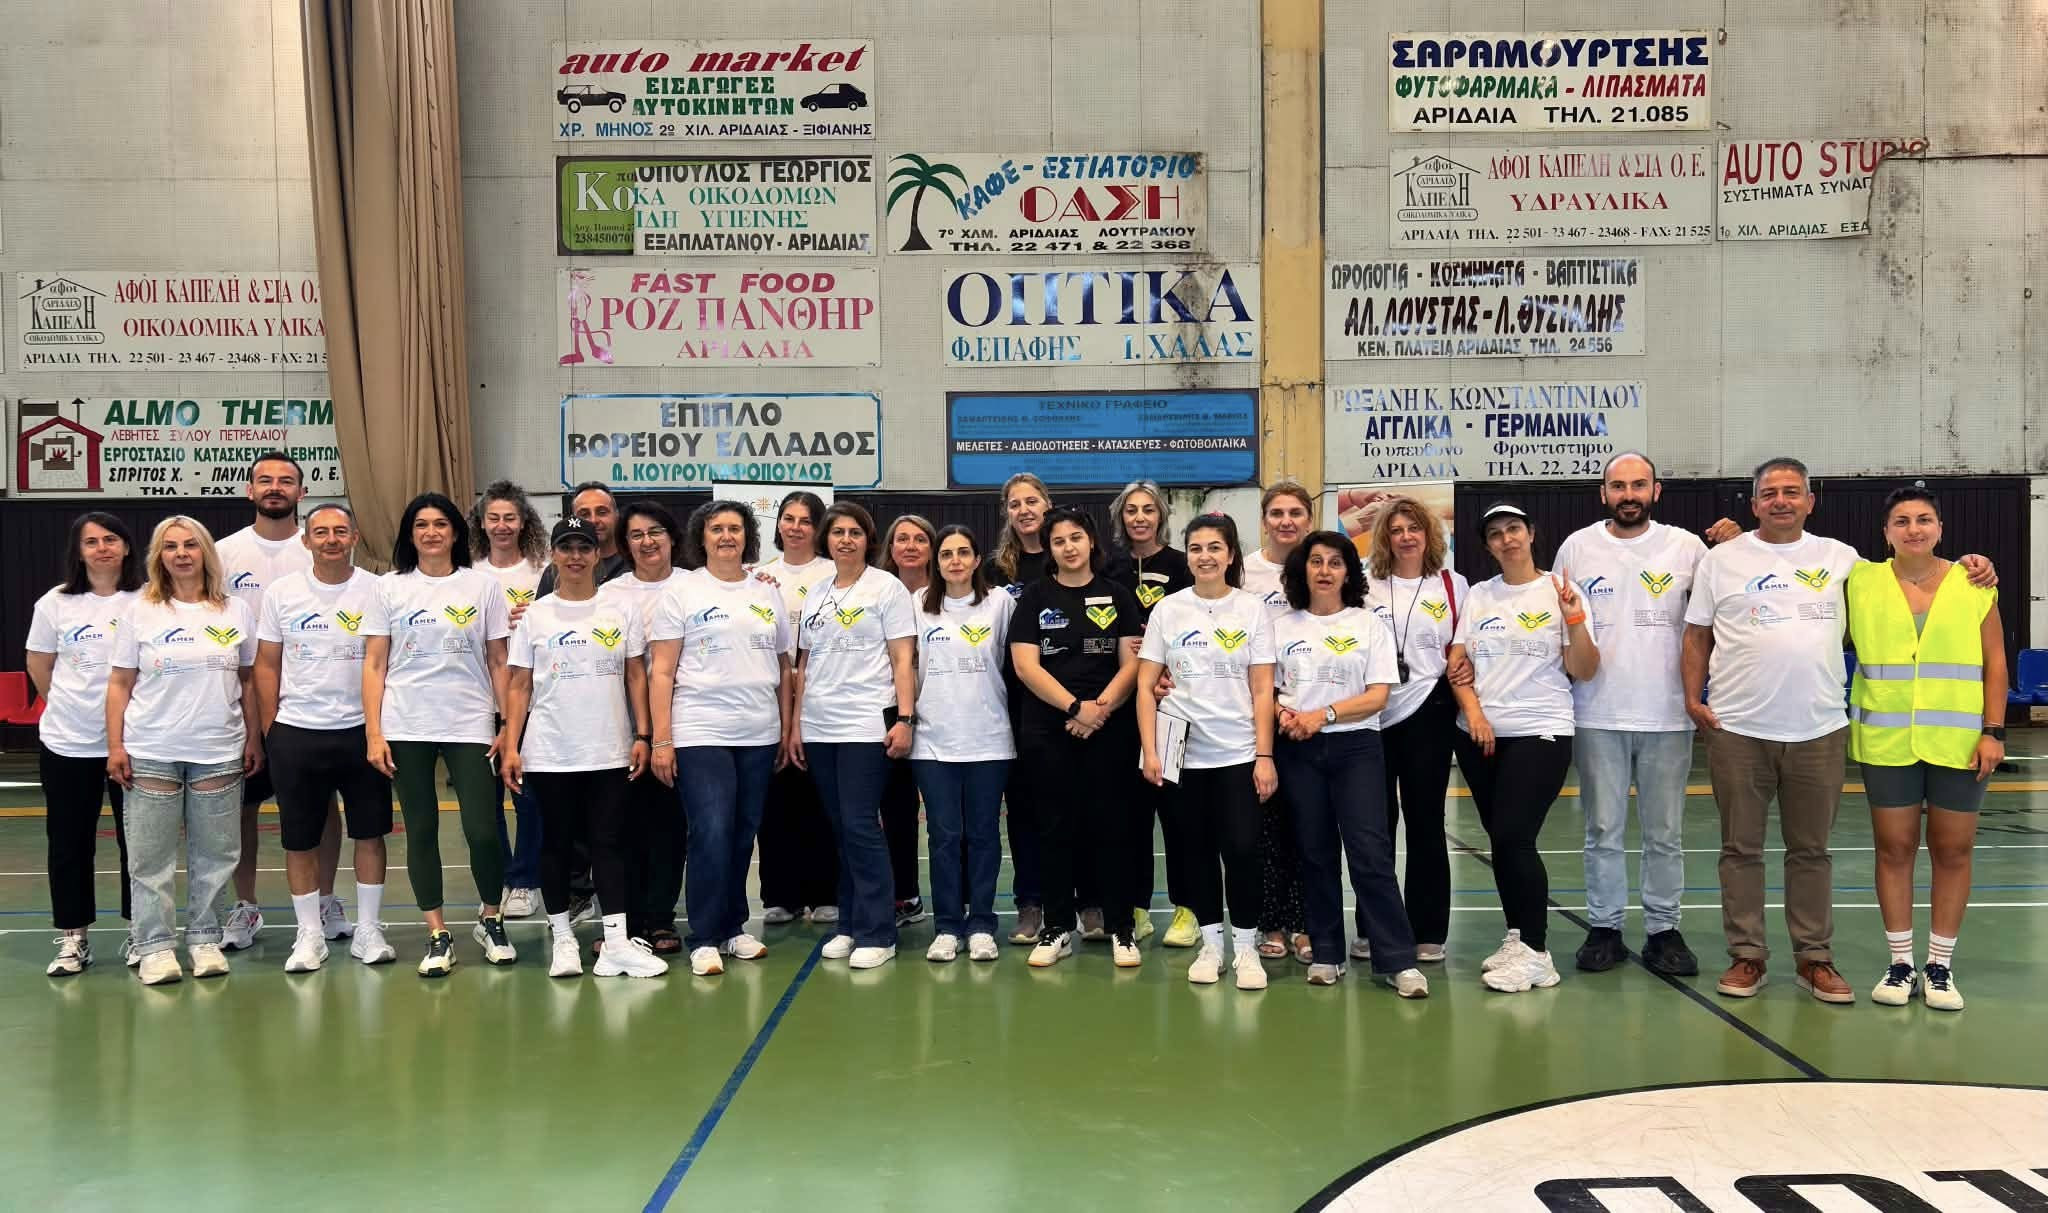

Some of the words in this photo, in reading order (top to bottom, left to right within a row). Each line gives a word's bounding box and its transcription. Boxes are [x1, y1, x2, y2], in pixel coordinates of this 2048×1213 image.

[559, 48, 669, 74] auto
[687, 44, 867, 73] market
[1392, 37, 1708, 68] ΣΑΡΑΜΟΥΡΤΣΗΣ
[646, 77, 774, 95] ΕΙΣΑΓΩΓΕΣ
[1395, 75, 1558, 99] ΦΥΤΟΦΑΡΜΑΚΑ
[1582, 74, 1706, 98] ΛΙΠΑΣΜΑΤΑ
[632, 98, 794, 116] ΑΥΤΟΚΙΝΗΤΩΝ
[1412, 106, 1517, 124] ΑΡΙΔΑΙΑ
[1544, 106, 1601, 123] ΤΗΛ.
[1611, 106, 1688, 123] 21.085
[560, 123, 584, 137] ΧΡ.
[596, 123, 653, 136] ΜΗΝΟΣ
[685, 124, 714, 136] ΧΙΛ.
[719, 123, 788, 136] ΑΡΙΔΑΙΑΣ
[803, 123, 872, 136] ΞΙΦΙΑΝΗΣ
[634, 163, 750, 183] ΟΠΟΥΛΟΣ
[760, 161, 871, 183] ΓΕΩΡΓΙΟΣ
[1488, 156, 1530, 179] ΑΦΟΙ
[1539, 153, 1610, 178] ΚΑΠΕΛΗ
[1670, 152, 1686, 177] Ο.
[1692, 153, 1705, 176] Ε.
[1723, 141, 1803, 186] AUTO
[689, 186, 837, 206] ΟΙΚΟΔΟΜΩΝ
[957, 160, 1021, 220] ΚΑΦΕ
[1043, 155, 1195, 180] ΕΣΤΙΑΤΟΡΙΟ
[1724, 184, 1813, 203] ΣΥΣΤΗΜΑΤΑ
[1020, 184, 1179, 223] ΟΑΣΗ
[1510, 192, 1669, 212] ΥΔΡΑΥΛΙΚΑ
[701, 210, 809, 229] ΥΓΙΕΙΝΗΣ
[961, 229, 997, 238] ΧΛΜ.
[1009, 229, 1079, 238] ΑΡΙΔΑΙΑΣ
[1099, 227, 1196, 237] ΛΟΥΤΡΑΚΙΟΥ
[1401, 228, 1459, 240] ΑΡΙΔΑΙΑ
[1467, 228, 1499, 240] ΤΗΛ.
[1598, 226, 1630, 237] 23468
[1641, 226, 1671, 237] FAX:
[1738, 225, 1762, 236] ΧΙΛ.
[1768, 224, 1828, 235] ΑΡΙΔΑΙΑΣ
[644, 233, 775, 251] ΕΞΑΠΛΑΤΑΝΟΥ
[787, 233, 870, 251] ΑΡΙΔΑΙΑΣ
[949, 242, 1000, 252] ΤΗΛ.
[1011, 242, 1037, 251] 22
[1044, 242, 1081, 251] 471
[1092, 242, 1108, 250] &
[1116, 241, 1144, 250] 22
[1151, 240, 1191, 249] 368
[631, 273, 716, 294] FAST
[740, 273, 835, 294] FOOD
[1331, 263, 1408, 292] ΩΡΟΛΟΓΙΑ
[1430, 259, 1524, 288] ΚΟΣΜΗΜΑΤΑ
[1546, 258, 1637, 287] ΒΑΠΤΙΣΤΙΚΑ
[114, 278, 158, 305] ΑΦΟΙ
[165, 279, 240, 304] ΚΑΠΕΛΗ
[946, 269, 1254, 327] ΟΠΤΙΚΑ
[600, 297, 683, 330] ΡΟΖ
[696, 297, 874, 331] ΠΑΝΘΗΡ
[123, 319, 259, 337] ΟΙΚΟΔΟΜΙΚΑ
[264, 318, 326, 336] ΥΛΙΚΑ
[677, 340, 814, 358] ΑΡΙΔΑΙΑ
[1149, 331, 1254, 360] ΧΑΛΑΣ
[1358, 341, 1390, 357] ΚΕΝ.
[1394, 340, 1453, 356] ΠΛΑΤΕΙΑ
[1457, 338, 1521, 355] ΑΡΙΔΑΙΑΣ
[1530, 338, 1560, 354] ΤΗΛ.
[23, 353, 80, 365] ΑΡΙΔΑΙΑ
[88, 353, 120, 364] ΤΗΛ.
[145, 352, 165, 364] 501
[195, 352, 215, 364] 467
[227, 352, 261, 364] 23468
[271, 352, 303, 364] FAX:
[1424, 388, 1444, 411] Κ.
[1449, 385, 1641, 410] ΚΩΝΣΤΑΝΤΙΝΙΔΟΥ
[104, 399, 201, 427] ALMO
[660, 402, 782, 428] ΕΠΙΠΛΟ
[112, 430, 160, 440] ΛΕΒΗΤΕΣ
[170, 430, 211, 441] ΞΥΛΟΥ
[220, 429, 288, 440] ΠΕΤΡΕΛΑΙΟΥ
[1366, 415, 1452, 440] ΑΓΓΛΙΚΑ
[1485, 412, 1608, 438] ΓΕΡΜΑΝΙΚΑ
[568, 432, 703, 457] ΒΟΡΕΙΟΥ
[716, 432, 875, 457] ΕΛΛΑΔΟΣ
[956, 441, 1003, 451] ΜΕΛΕΤΕΣ
[1011, 440, 1090, 451] ΑΔΕΙΟΔΟΤΗΣΕΙΣ
[1098, 439, 1161, 450] ΚΑΤΑΣΚΕΥΕΣ
[1360, 443, 1380, 456] Το
[1493, 441, 1613, 458] Φροντιστηριο
[104, 447, 186, 462] ΕΡΓΟΣΤΑΣΙΟ
[170, 468, 183, 482] Χ.
[1372, 463, 1459, 478] ΑΡΙΔΑΙΑ
[1485, 462, 1534, 476] ΤΗΛ.
[200, 486, 236, 496] FAX
